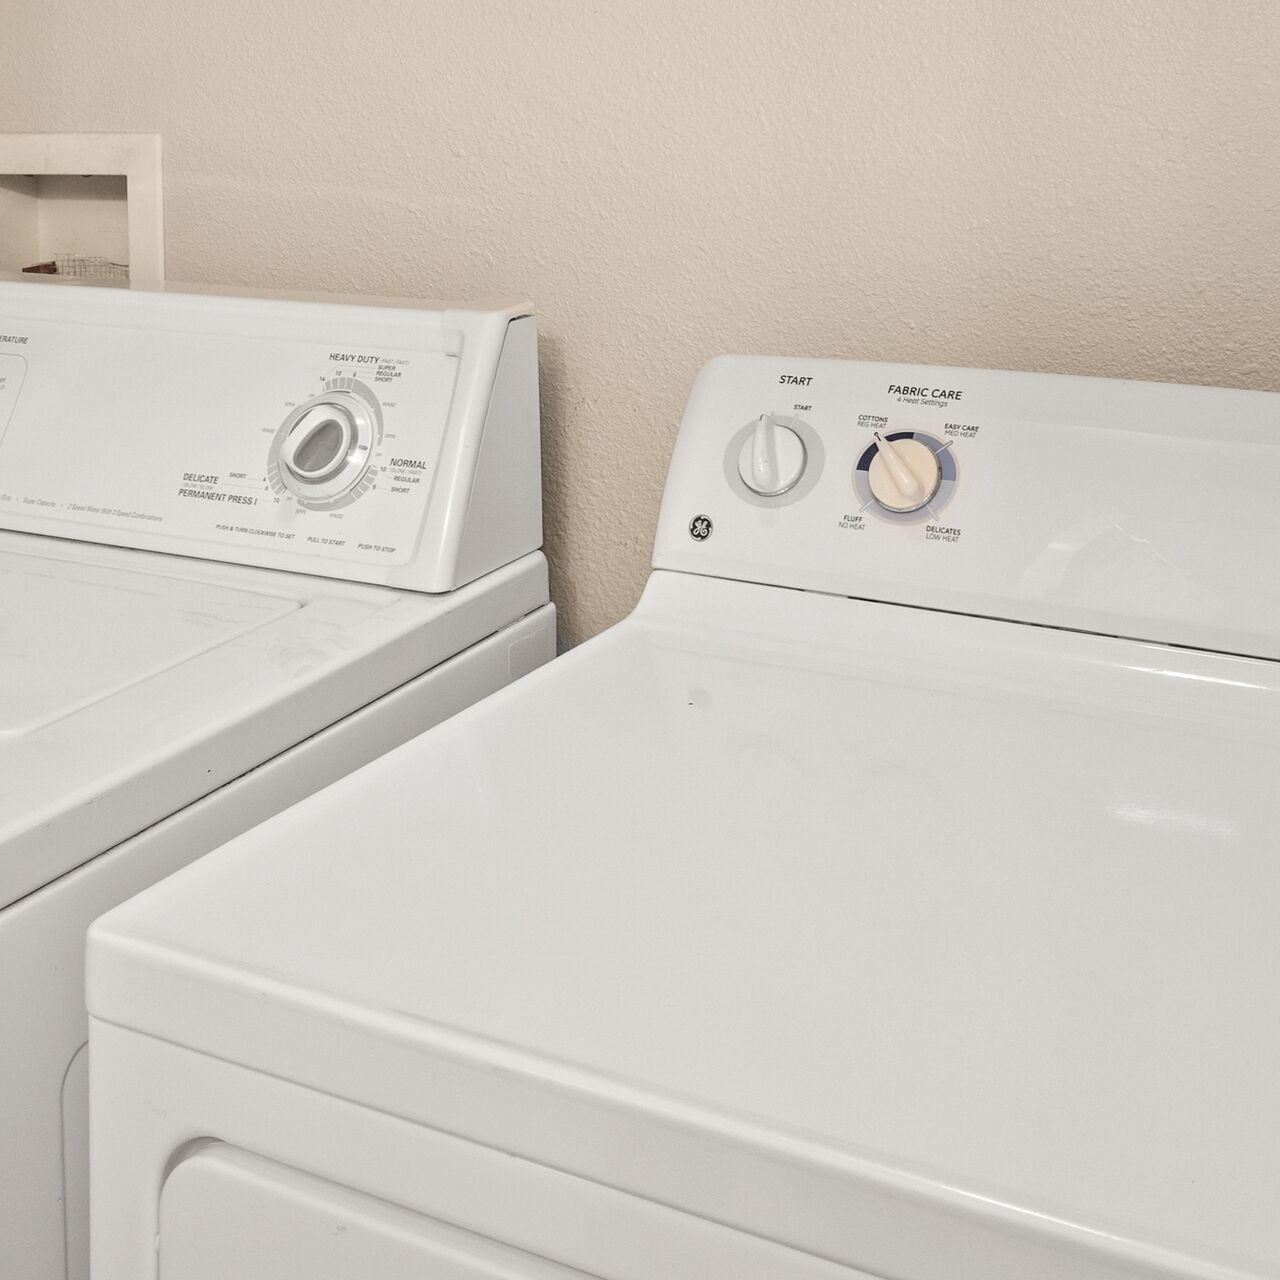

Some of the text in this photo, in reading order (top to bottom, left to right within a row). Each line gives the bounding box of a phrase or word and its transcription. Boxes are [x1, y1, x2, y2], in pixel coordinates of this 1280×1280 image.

[329, 353, 356, 362] HEAVY
[357, 355, 380, 364] DUTY
[779, 374, 813, 387] START
[887, 384, 963, 401] FABRIC CARE
[903, 396, 920, 404] Heat
[920, 398, 948, 408] Settings
[793, 404, 812, 412] START
[858, 414, 888, 423] COTTONS
[857, 420, 887, 429] REG HEAT
[944, 423, 979, 433] EASY CARE
[944, 429, 977, 439] MED HEAT
[390, 458, 427, 470] NORMAL
[183, 472, 219, 485] DELICATE
[393, 475, 420, 483] REGULAR
[178, 489, 227, 502] PERMANENT
[227, 495, 253, 505] PRESS
[838, 521, 866, 531] NO HEAT
[926, 525, 961, 536] DELICATES
[248, 528, 277, 537] CLOCKWISE
[307, 536, 320, 544] PULL
[328, 539, 346, 547] START
[925, 533, 959, 543] LOW HEAT
